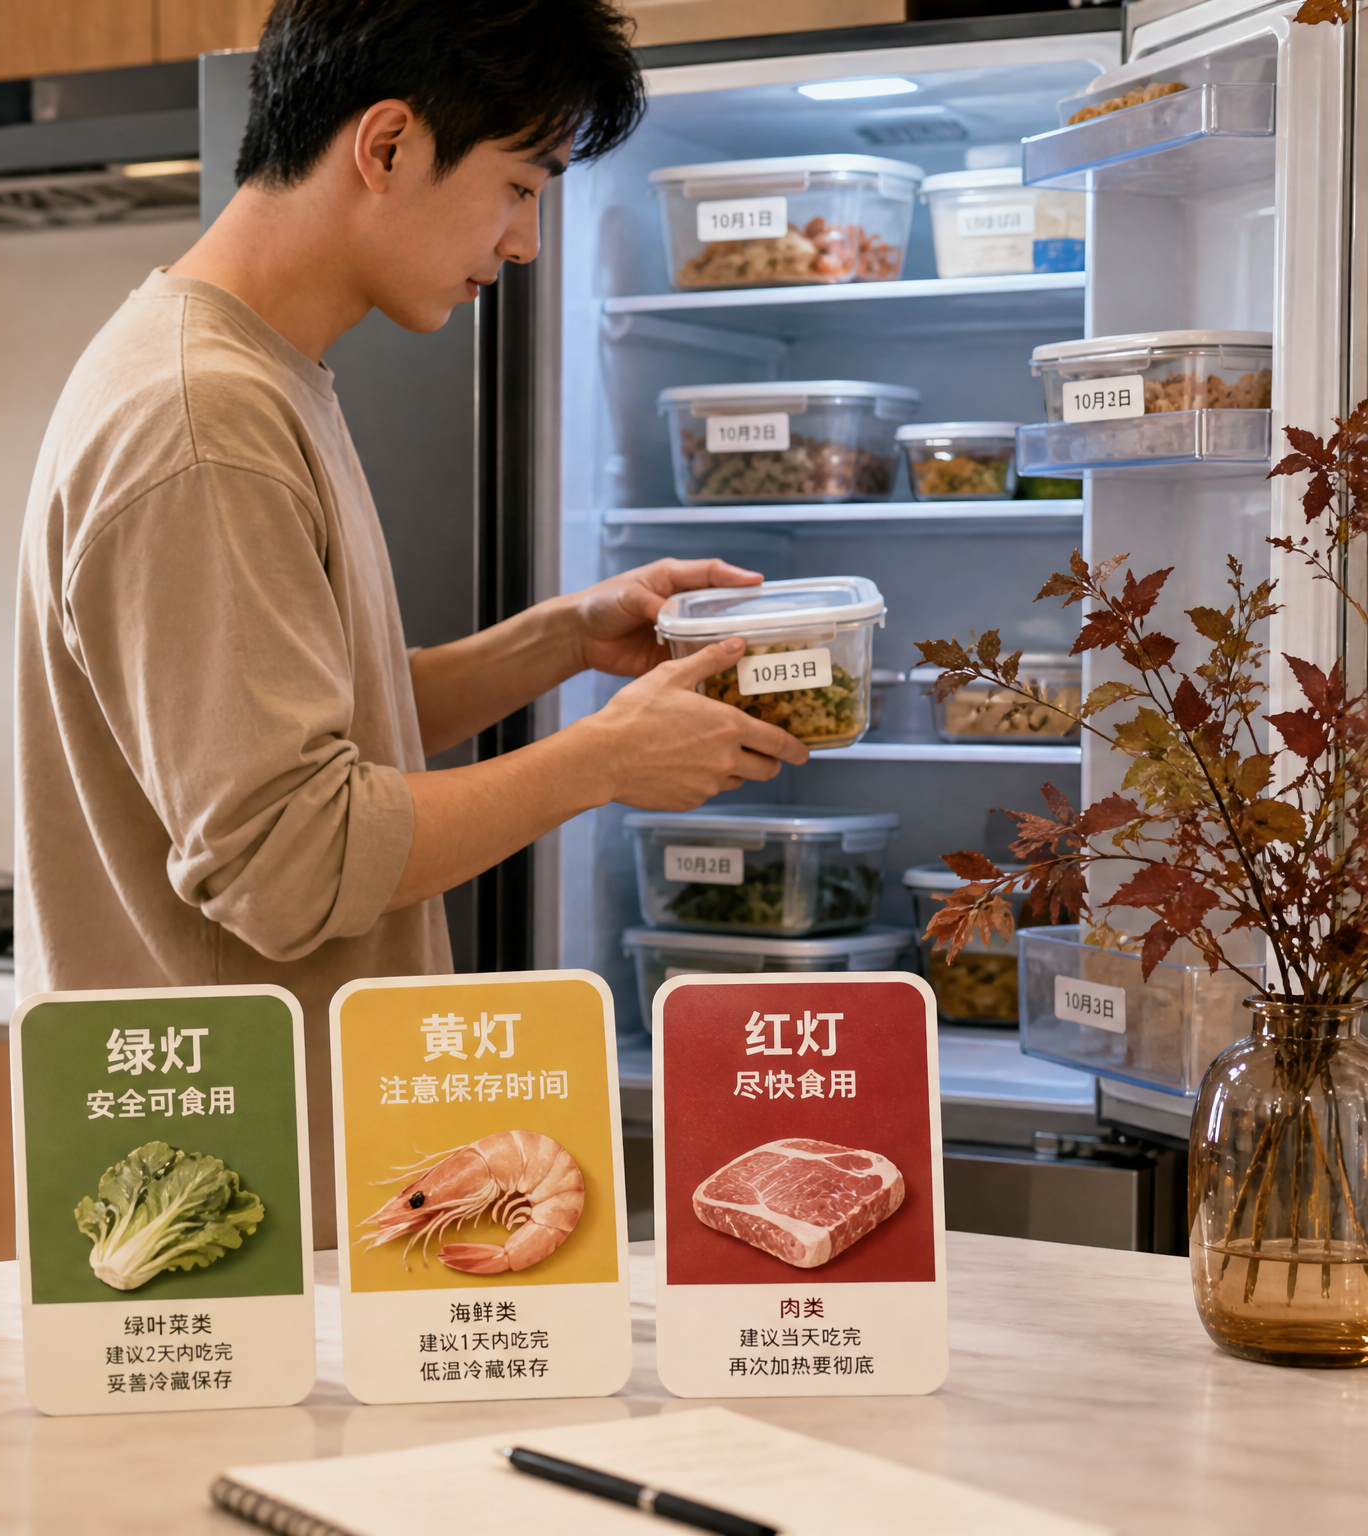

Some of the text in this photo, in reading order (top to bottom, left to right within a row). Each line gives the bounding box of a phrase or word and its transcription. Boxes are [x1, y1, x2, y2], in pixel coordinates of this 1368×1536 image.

[712, 209, 772, 229] 10月1日
[752, 661, 817, 683] 10月3日
[676, 857, 732, 875] 10月2日
[1065, 991, 1115, 1019] 10月3日
[420, 1012, 522, 1063] 黄灯
[745, 1010, 845, 1057] 红灯
[106, 1026, 209, 1076] 绿灯
[379, 1069, 569, 1105] 注意保存时间
[733, 1068, 857, 1100] 尽快食用
[86, 1086, 235, 1120] 安全可食用
[449, 1301, 518, 1323] 海鲜类
[780, 1297, 825, 1319] 肉类
[124, 1313, 213, 1336] 绿叶菜类
[419, 1329, 550, 1353] 建议1天内吃完
[739, 1327, 862, 1348] 建议当天吃完
[105, 1342, 234, 1365] 建议2天内吃完
[419, 1358, 550, 1382] 低温冷藏保存
[728, 1355, 875, 1377] 再次加热要彻底
[107, 1369, 233, 1394] 妥善冷藏保存
